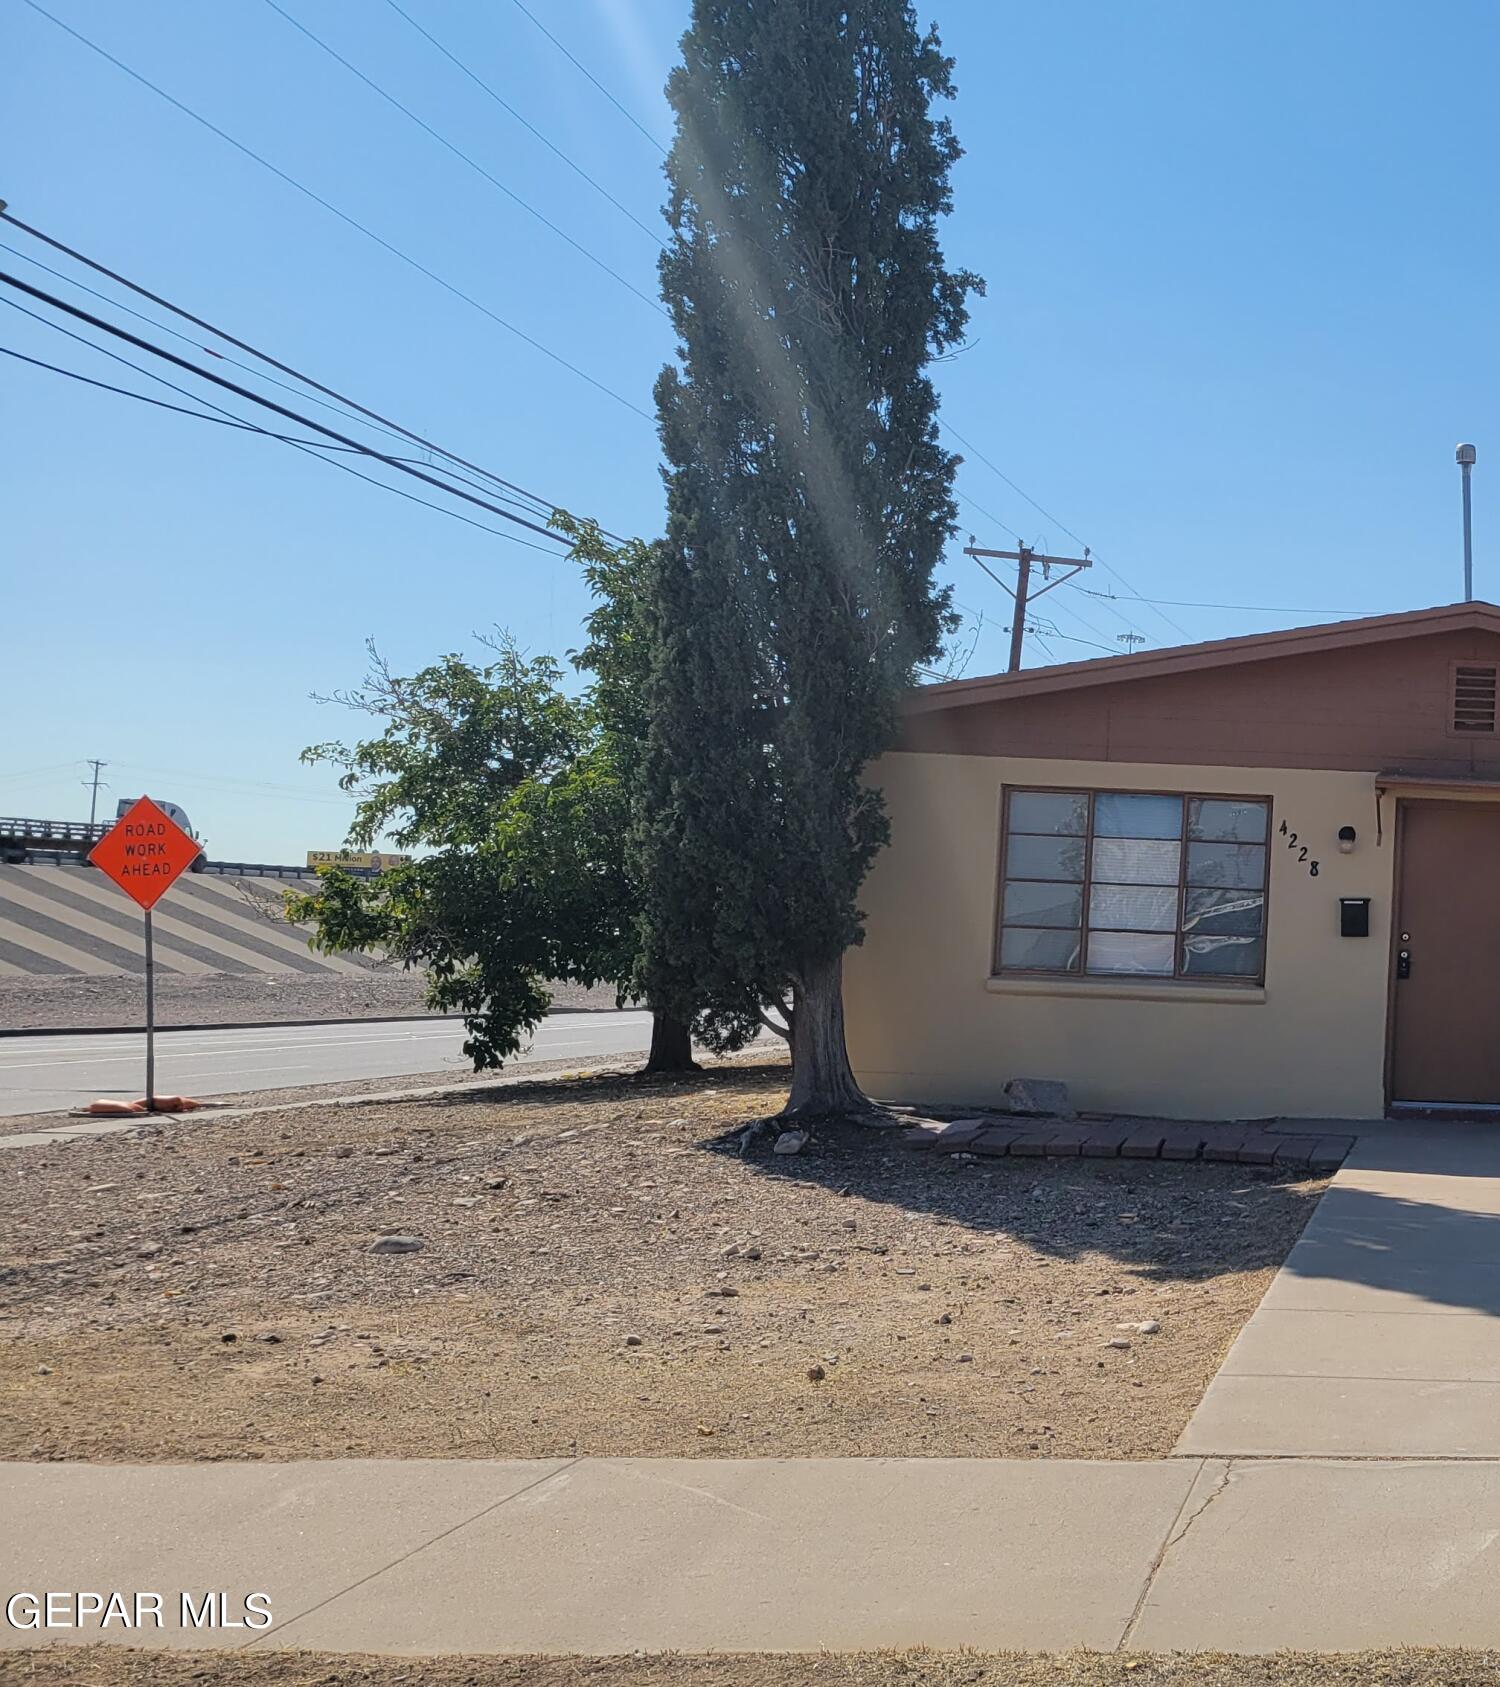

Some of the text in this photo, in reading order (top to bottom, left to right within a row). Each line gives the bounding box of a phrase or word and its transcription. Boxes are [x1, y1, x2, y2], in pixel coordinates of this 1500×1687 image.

[125, 823, 166, 837] ROAD
[125, 843, 166, 857] WORK
[1279, 819, 1319, 876] 4228
[312, 852, 362, 862] $21 Miion
[122, 863, 171, 876] AHEAD
